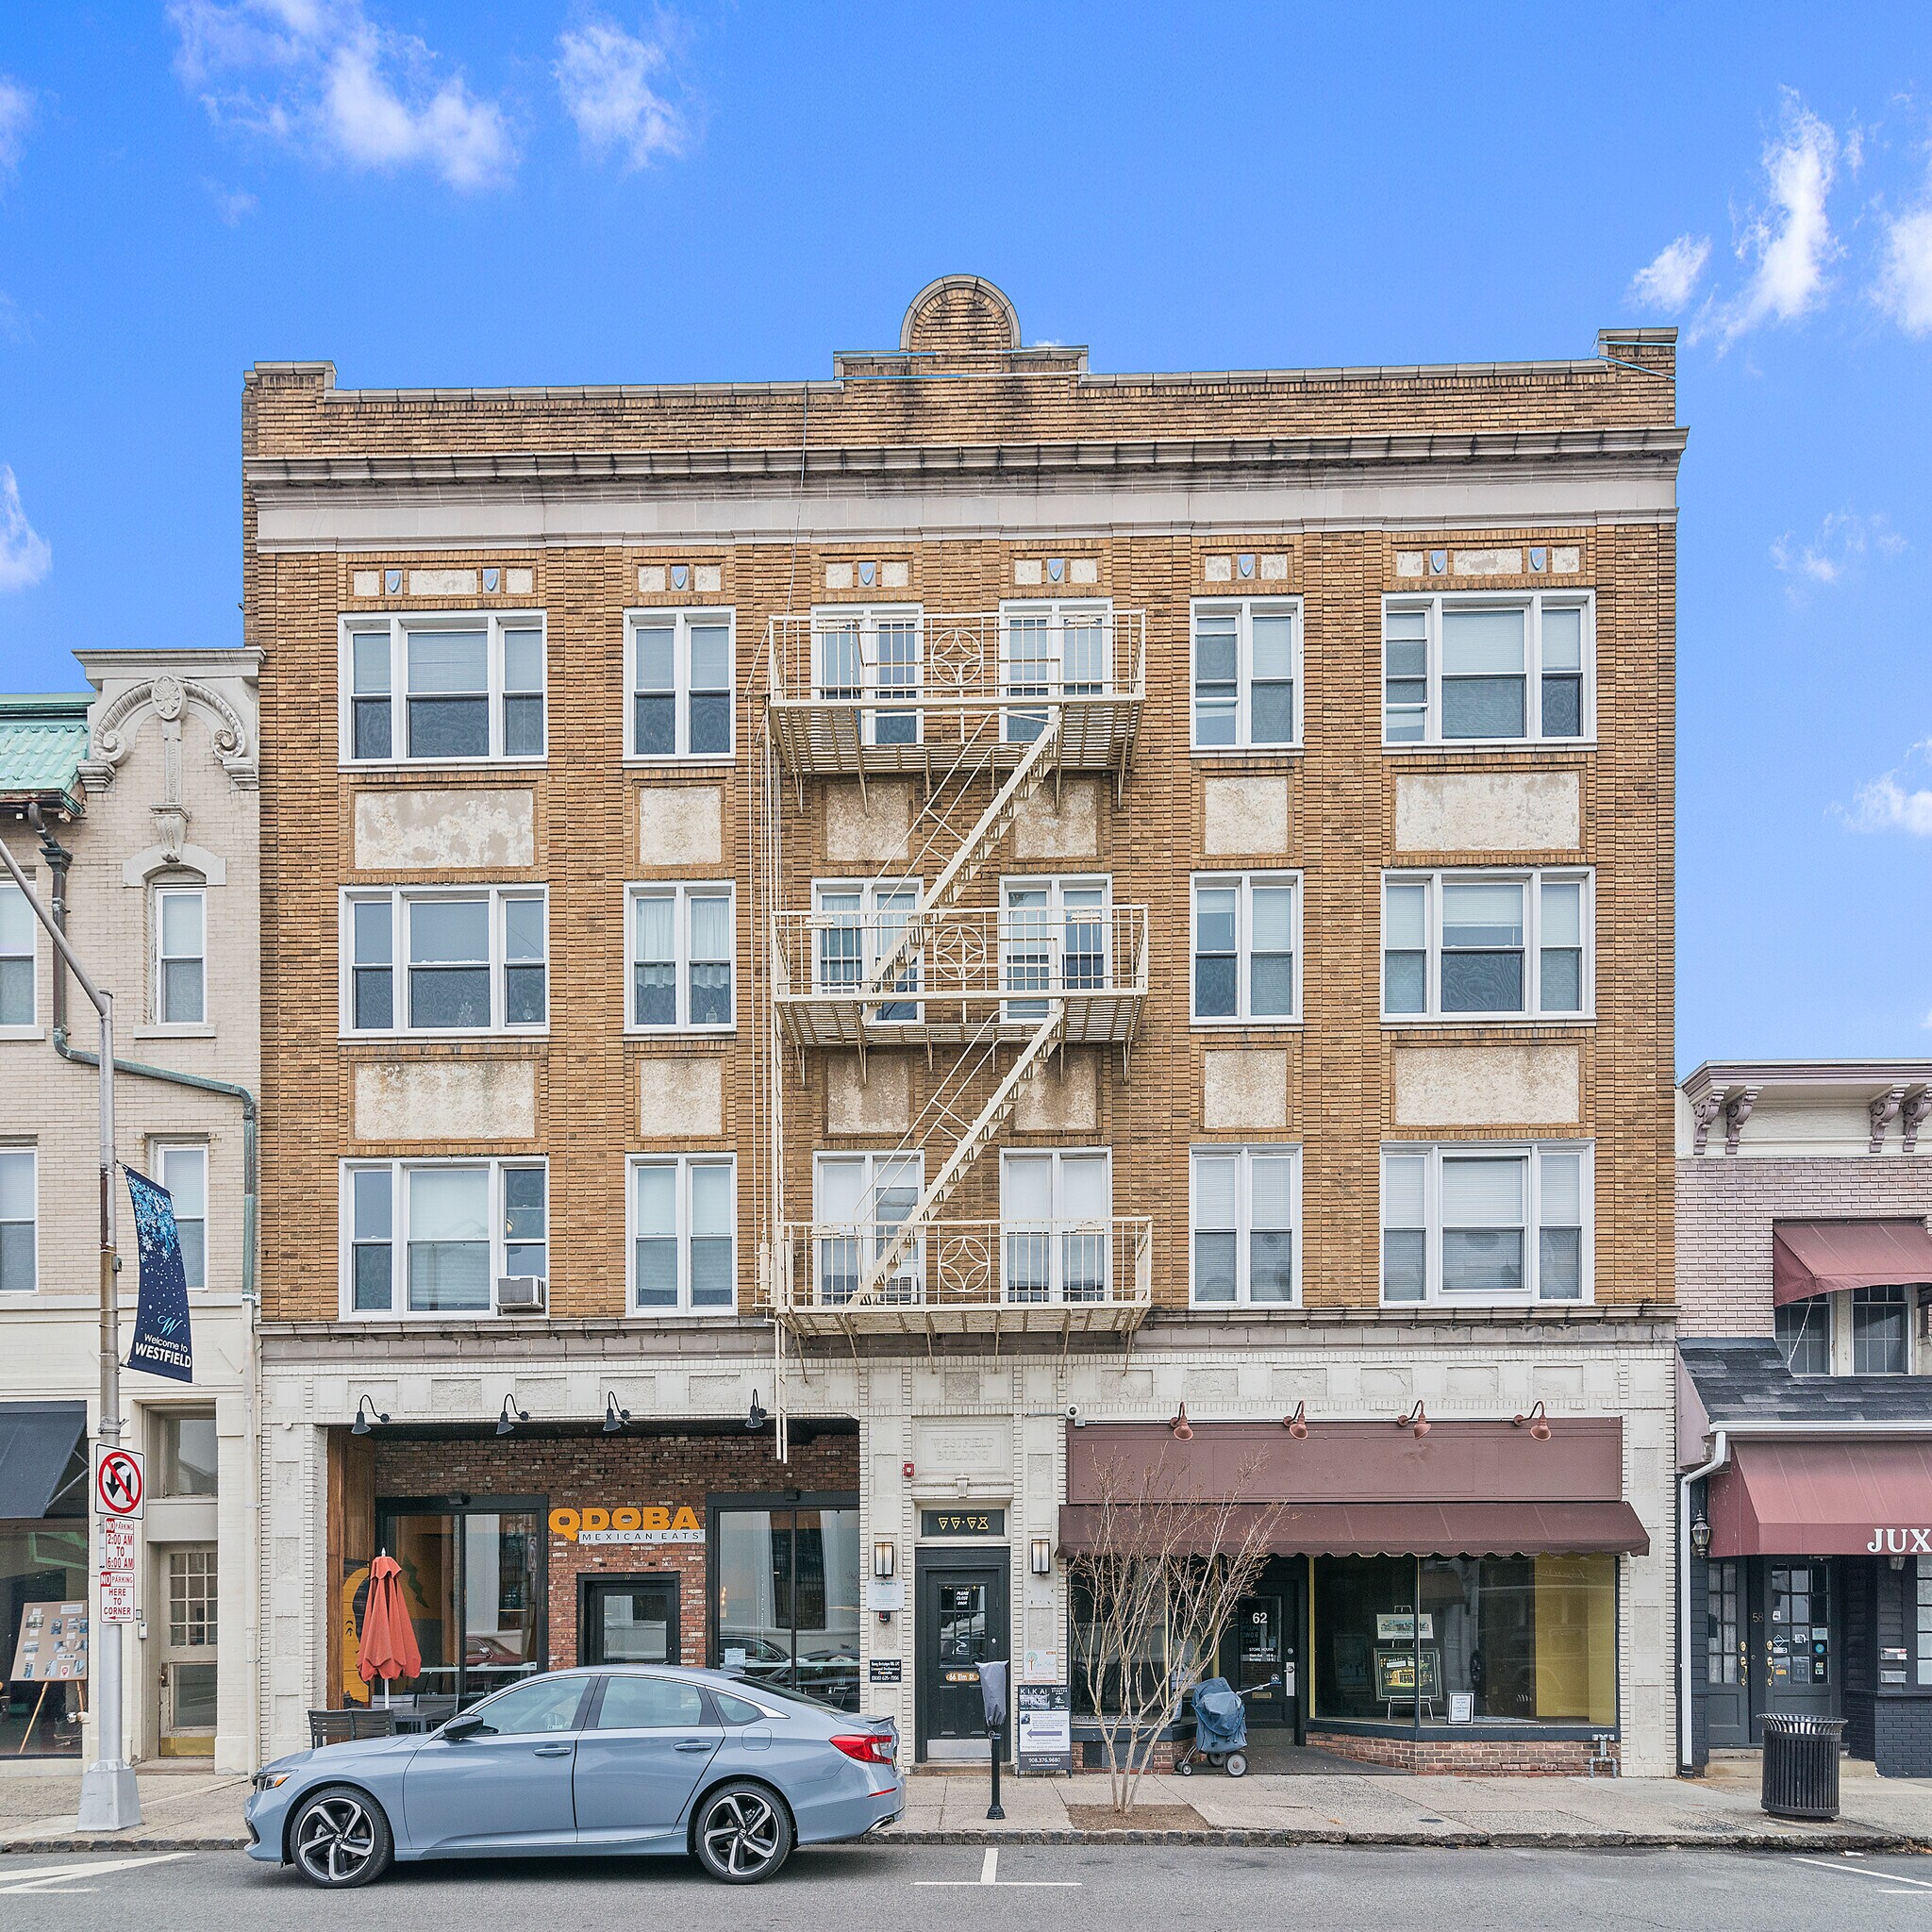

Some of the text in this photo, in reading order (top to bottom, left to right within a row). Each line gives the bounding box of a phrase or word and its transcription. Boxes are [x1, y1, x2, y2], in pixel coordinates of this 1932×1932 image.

[158, 1315, 183, 1336] W
[144, 1333, 188, 1353] Welcome to
[135, 1341, 192, 1368] WESTFIELD
[930, 1437, 994, 1448] WESTFIELD
[936, 1450, 990, 1461] BUILDING
[106, 1520, 133, 1532] NO PARKING
[548, 1507, 701, 1541] QDOBA
[107, 1533, 133, 1545] 2:00 AM
[1867, 1528, 1932, 1553] JUX
[116, 1546, 125, 1557] TO
[107, 1557, 134, 1569] 6:00 AM
[101, 1573, 133, 1585] NO PARKING
[104, 1607, 131, 1615] CORNER
[1252, 1612, 1268, 1624] 62
[1752, 1612, 1764, 1623] 58
